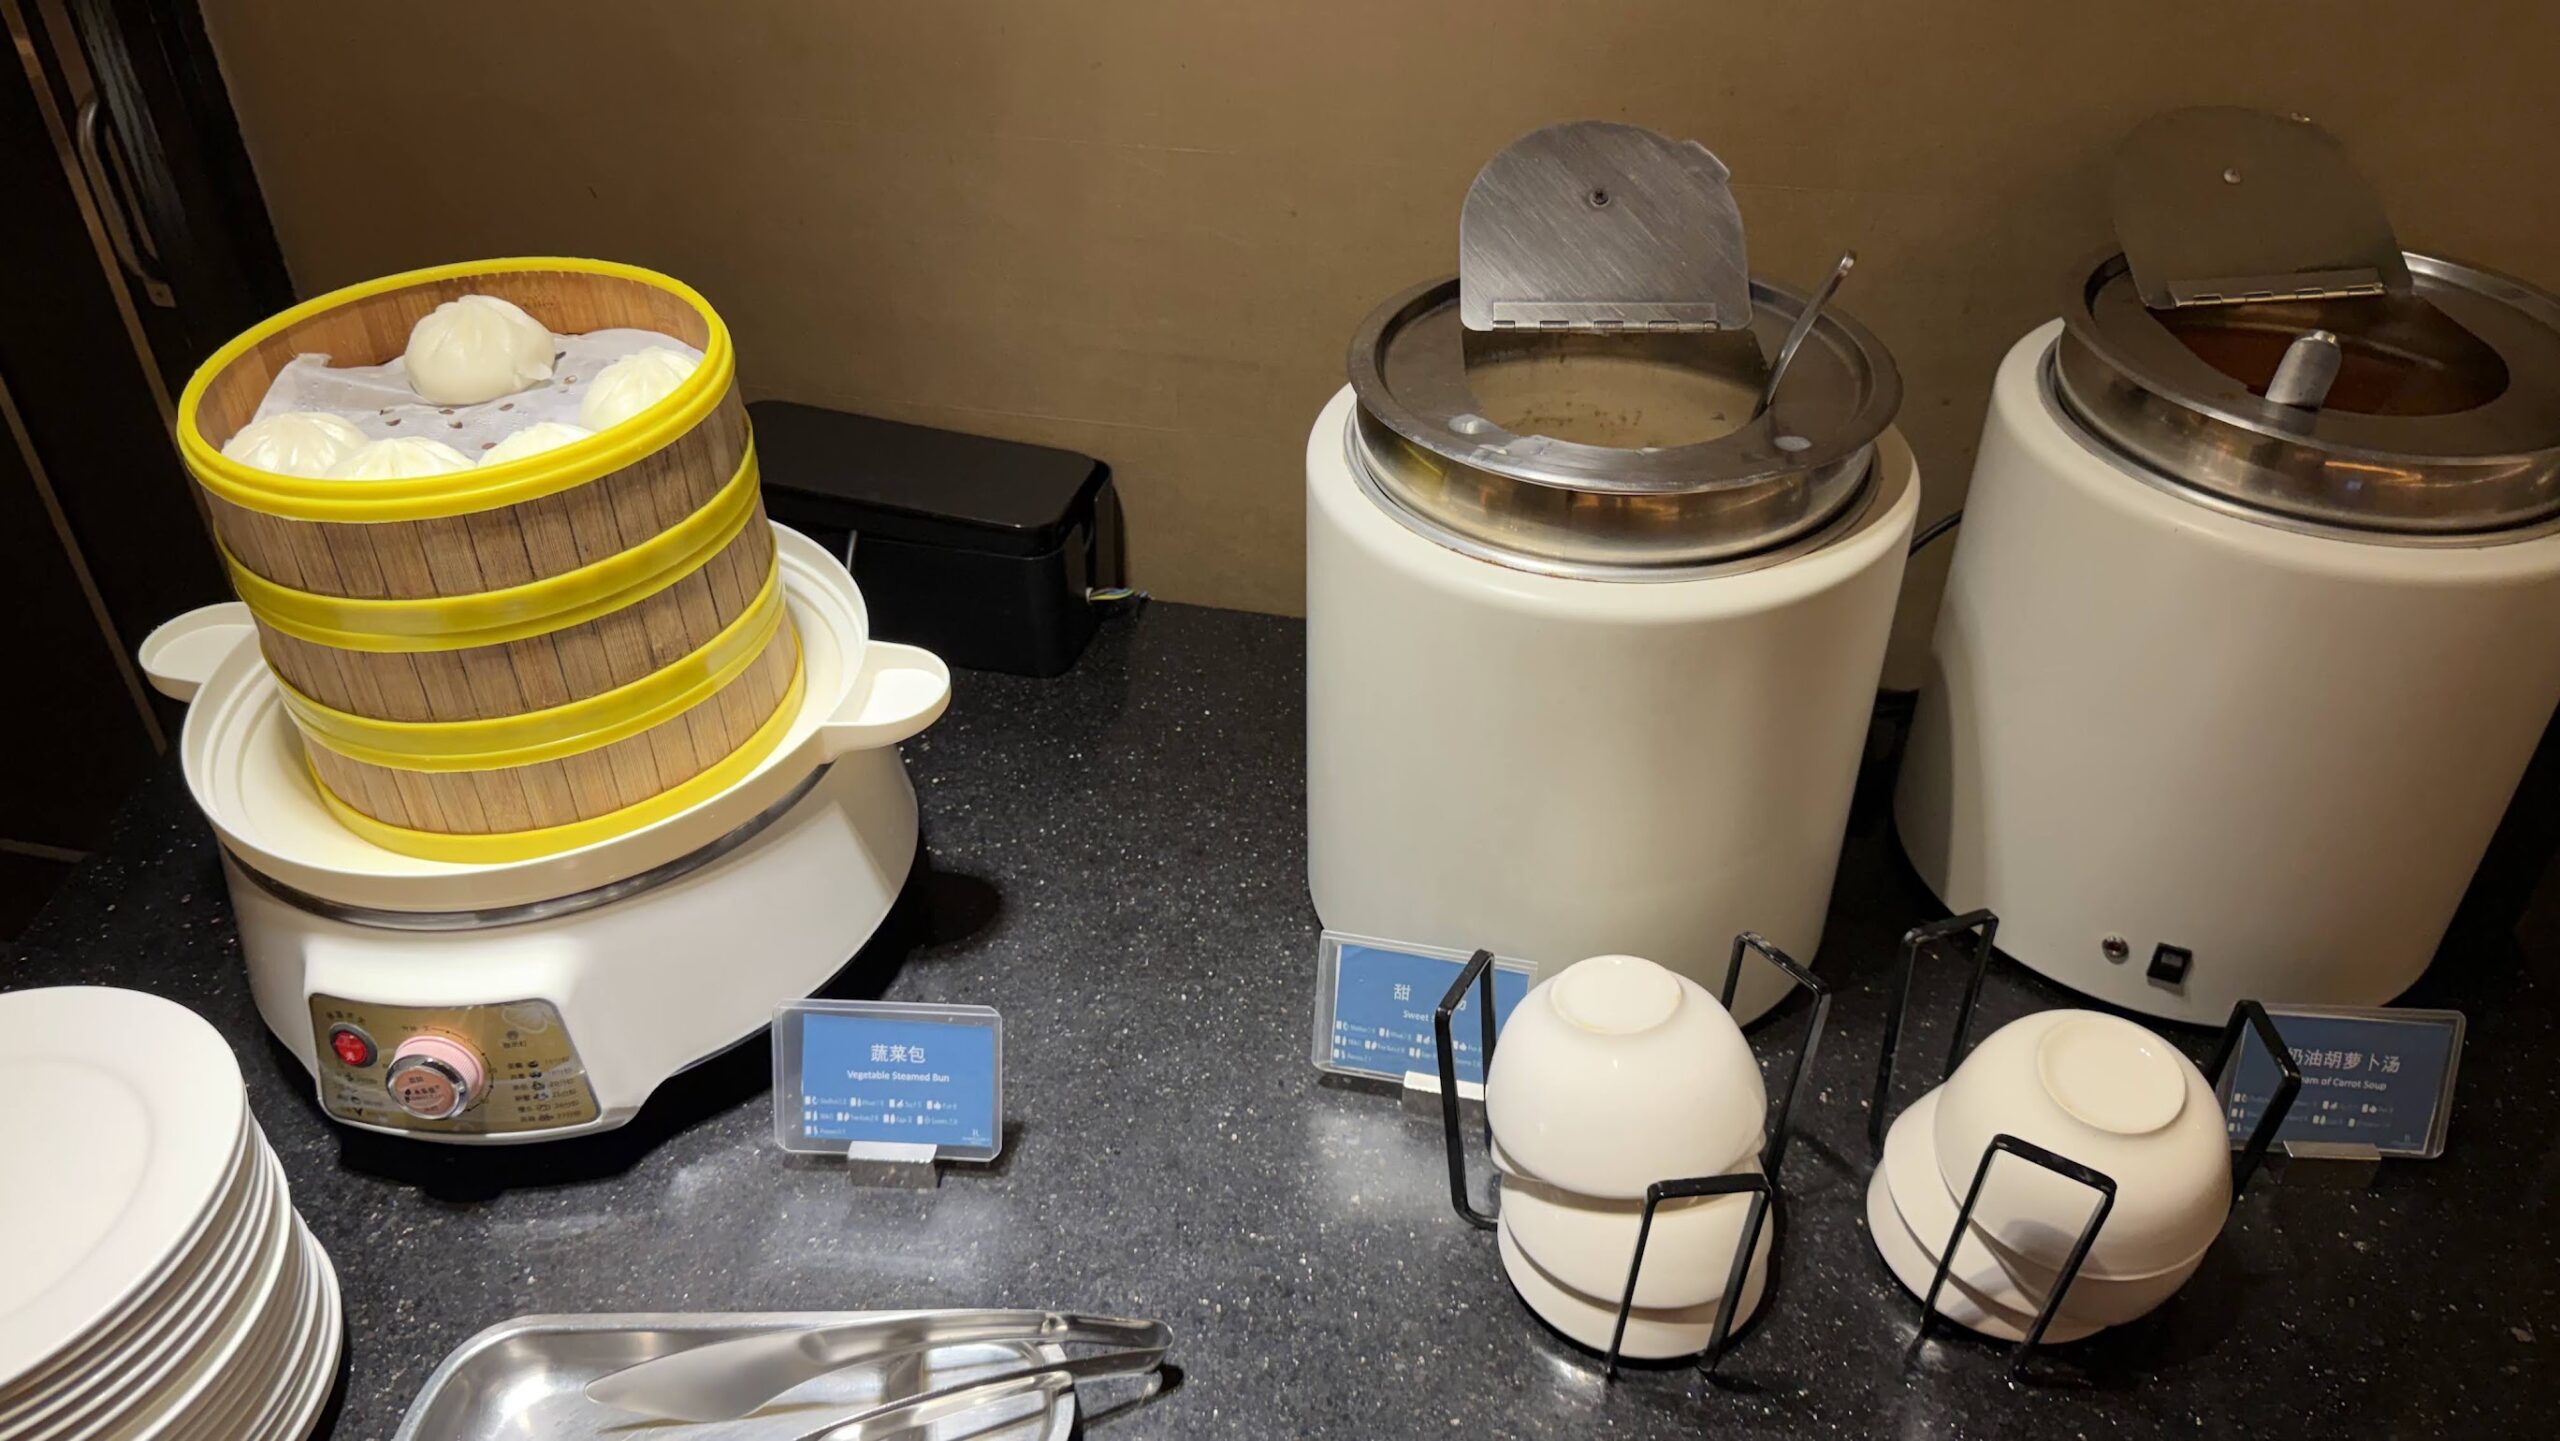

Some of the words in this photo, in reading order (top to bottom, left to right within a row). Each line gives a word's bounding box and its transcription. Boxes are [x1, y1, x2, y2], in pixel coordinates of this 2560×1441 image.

[1403, 1010, 1429, 1022] Sweet
[871, 1043, 925, 1063] 蔬菜包
[847, 1070, 889, 1081] Vegetable
[892, 1071, 930, 1082] Steamed
[932, 1073, 950, 1082] Bun
[2320, 1076, 2331, 1085] of
[2333, 1078, 2362, 1088] Carrot
[2363, 1080, 2387, 1091] Soup
